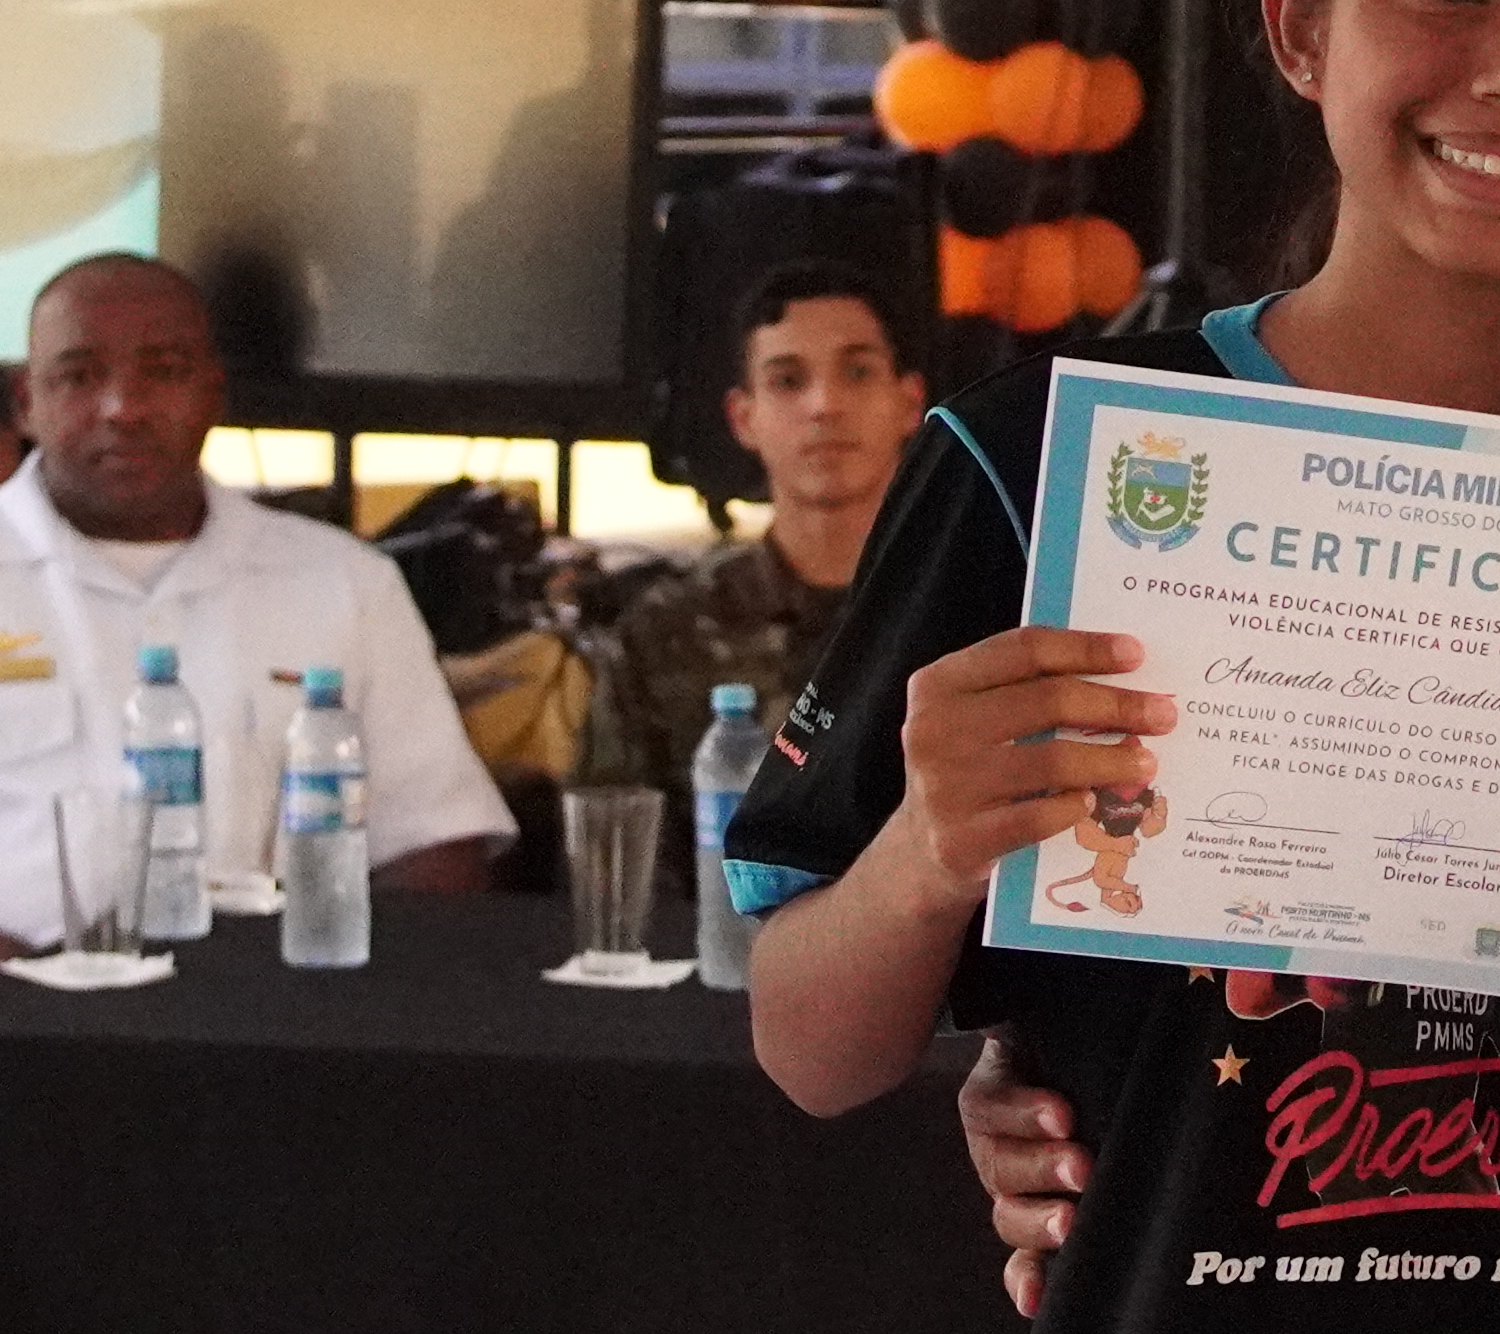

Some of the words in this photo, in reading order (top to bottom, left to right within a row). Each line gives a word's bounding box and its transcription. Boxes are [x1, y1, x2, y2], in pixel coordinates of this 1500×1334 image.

[1301, 452, 1445, 499] POLÍCIA
[1337, 499, 1392, 517] MATO
[1399, 505, 1475, 529] GROSSO
[1123, 576, 1137, 590] O
[1147, 579, 1260, 605] PROGRAMA
[1269, 593, 1407, 623] EDUCACIONAL
[1418, 612, 1442, 628] DE
[1228, 613, 1335, 639] VIOLÊNCIA
[1343, 627, 1441, 651] CERTIFICA
[1450, 639, 1490, 657] QUE
[1204, 655, 1335, 693] Amanda
[1186, 701, 1276, 722] CONCLUIU
[1284, 711, 1296, 723] O
[1303, 712, 1401, 735] CURRÍCULO
[1408, 724, 1433, 738] DO
[1441, 727, 1497, 746] CURSO
[1198, 726, 1221, 740] NA
[1289, 736, 1392, 758] ASSUMINDO
[1400, 747, 1411, 761] O
[1232, 754, 1280, 771] FICAR
[1287, 760, 1347, 777] LONGE
[1355, 767, 1387, 783] DAS
[1394, 771, 1463, 791] DROGAS
[1472, 779, 1480, 793] E
[1185, 831, 1245, 847] Alexandre
[1383, 866, 1439, 886] Diretor
[1444, 854, 1480, 869] Torres
[1406, 985, 1489, 1016] PROERD
[1415, 1020, 1474, 1051] PMMS
[1185, 1250, 1266, 1285] Por
[1274, 1254, 1342, 1283] um
[1357, 1247, 1481, 1282] futuro
